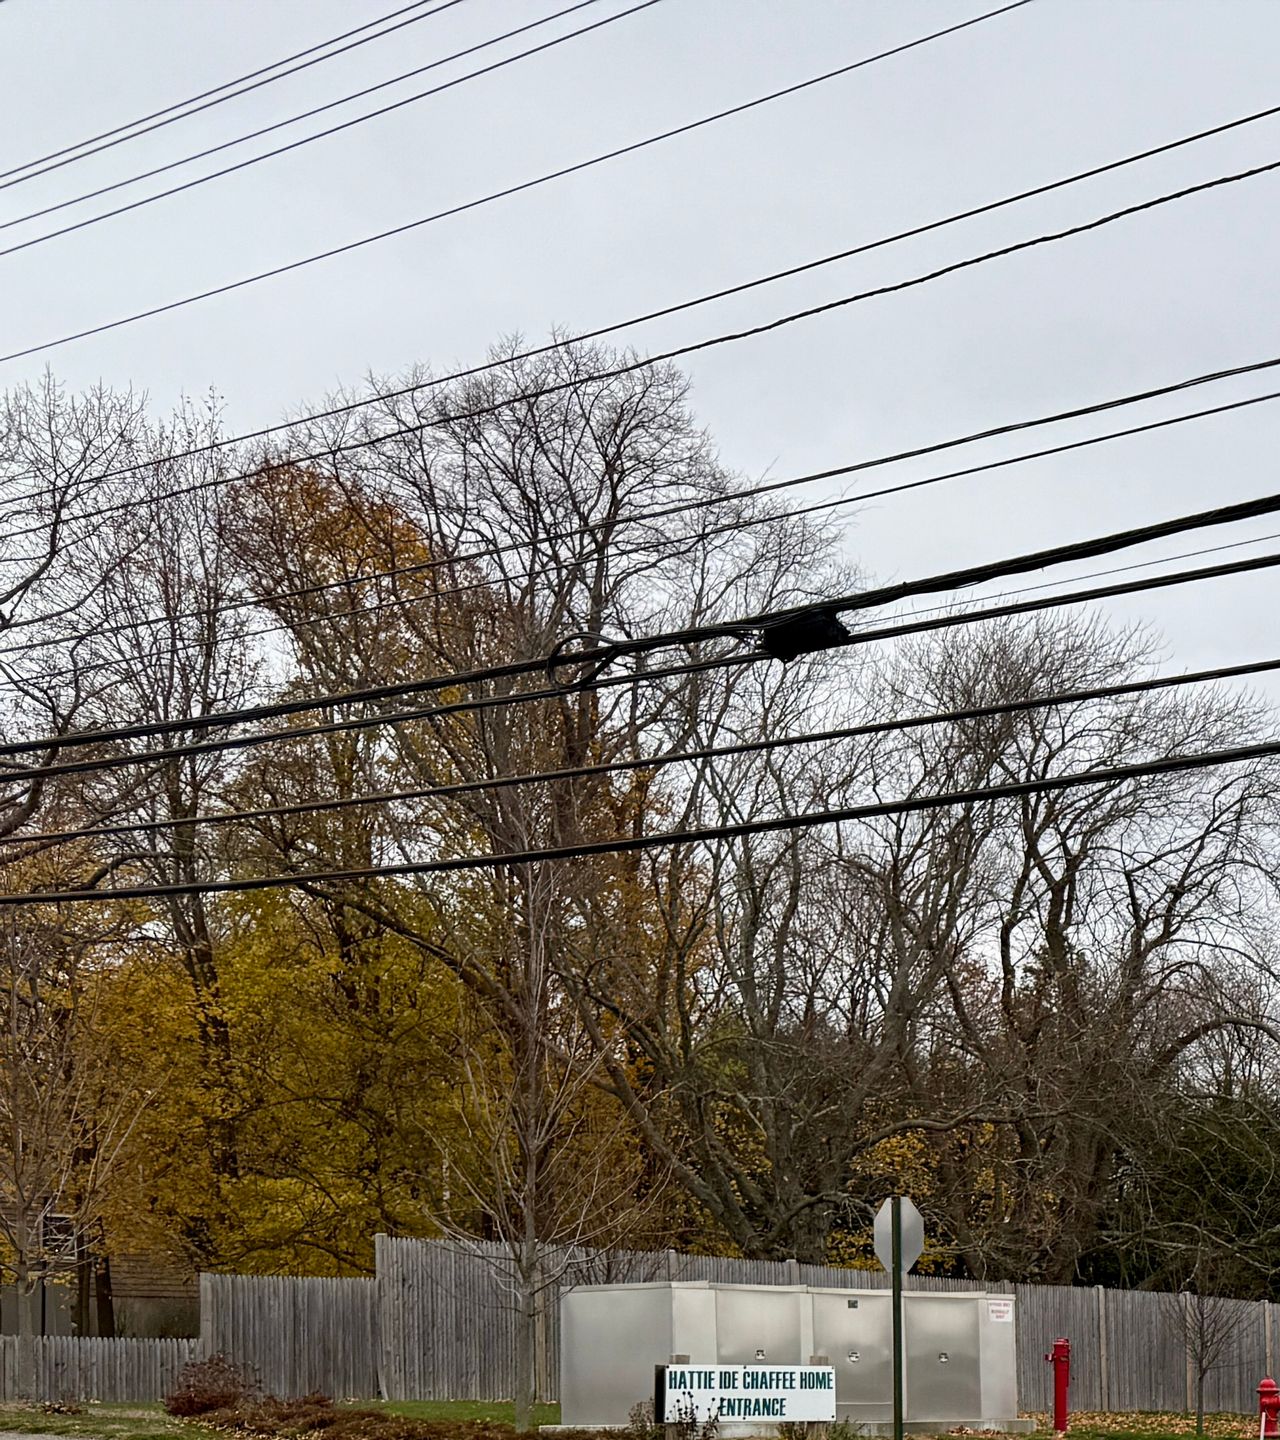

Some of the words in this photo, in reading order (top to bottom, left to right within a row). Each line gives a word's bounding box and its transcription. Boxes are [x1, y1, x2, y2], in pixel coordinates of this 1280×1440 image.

[668, 1370, 715, 1390] HATTIE
[719, 1370, 738, 1390] IDE
[742, 1371, 796, 1390] CHAFFEE
[799, 1371, 834, 1390] HOME
[719, 1397, 787, 1417] ENTRANCE
